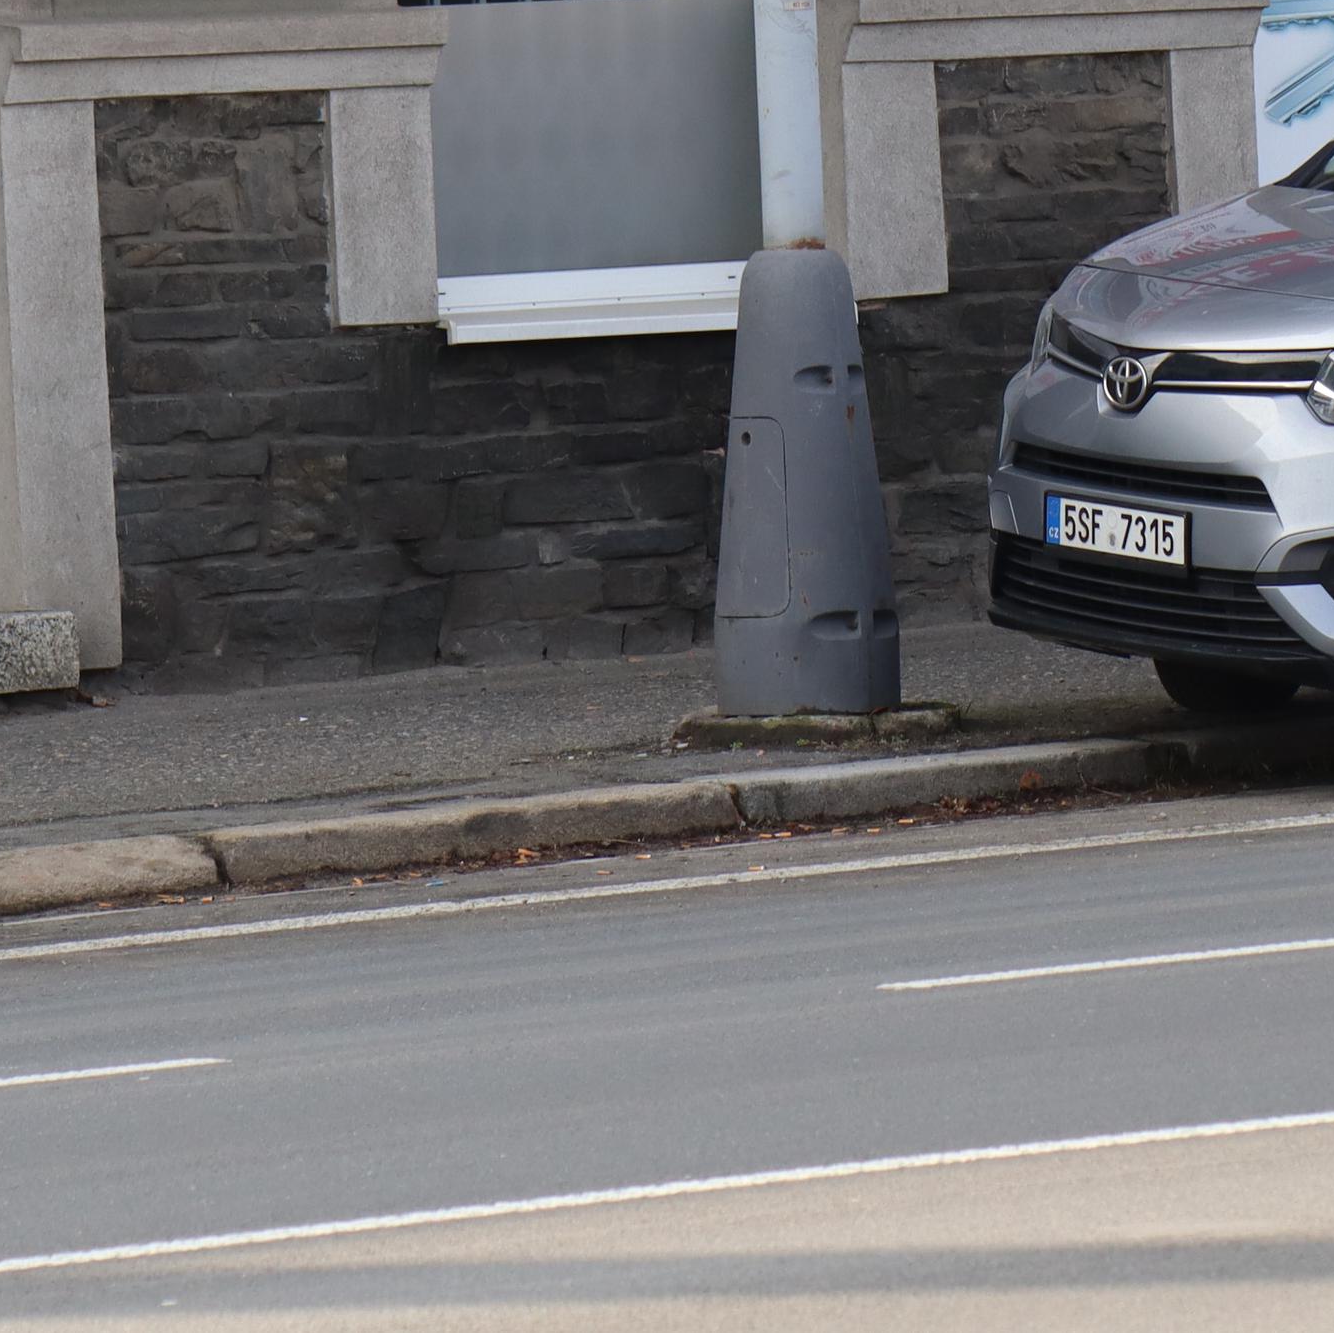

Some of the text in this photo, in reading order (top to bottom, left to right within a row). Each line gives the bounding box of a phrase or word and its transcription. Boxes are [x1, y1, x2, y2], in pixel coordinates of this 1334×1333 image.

[1048, 526, 1060, 539] CZ
[1064, 503, 1174, 557] 5SF 7315
